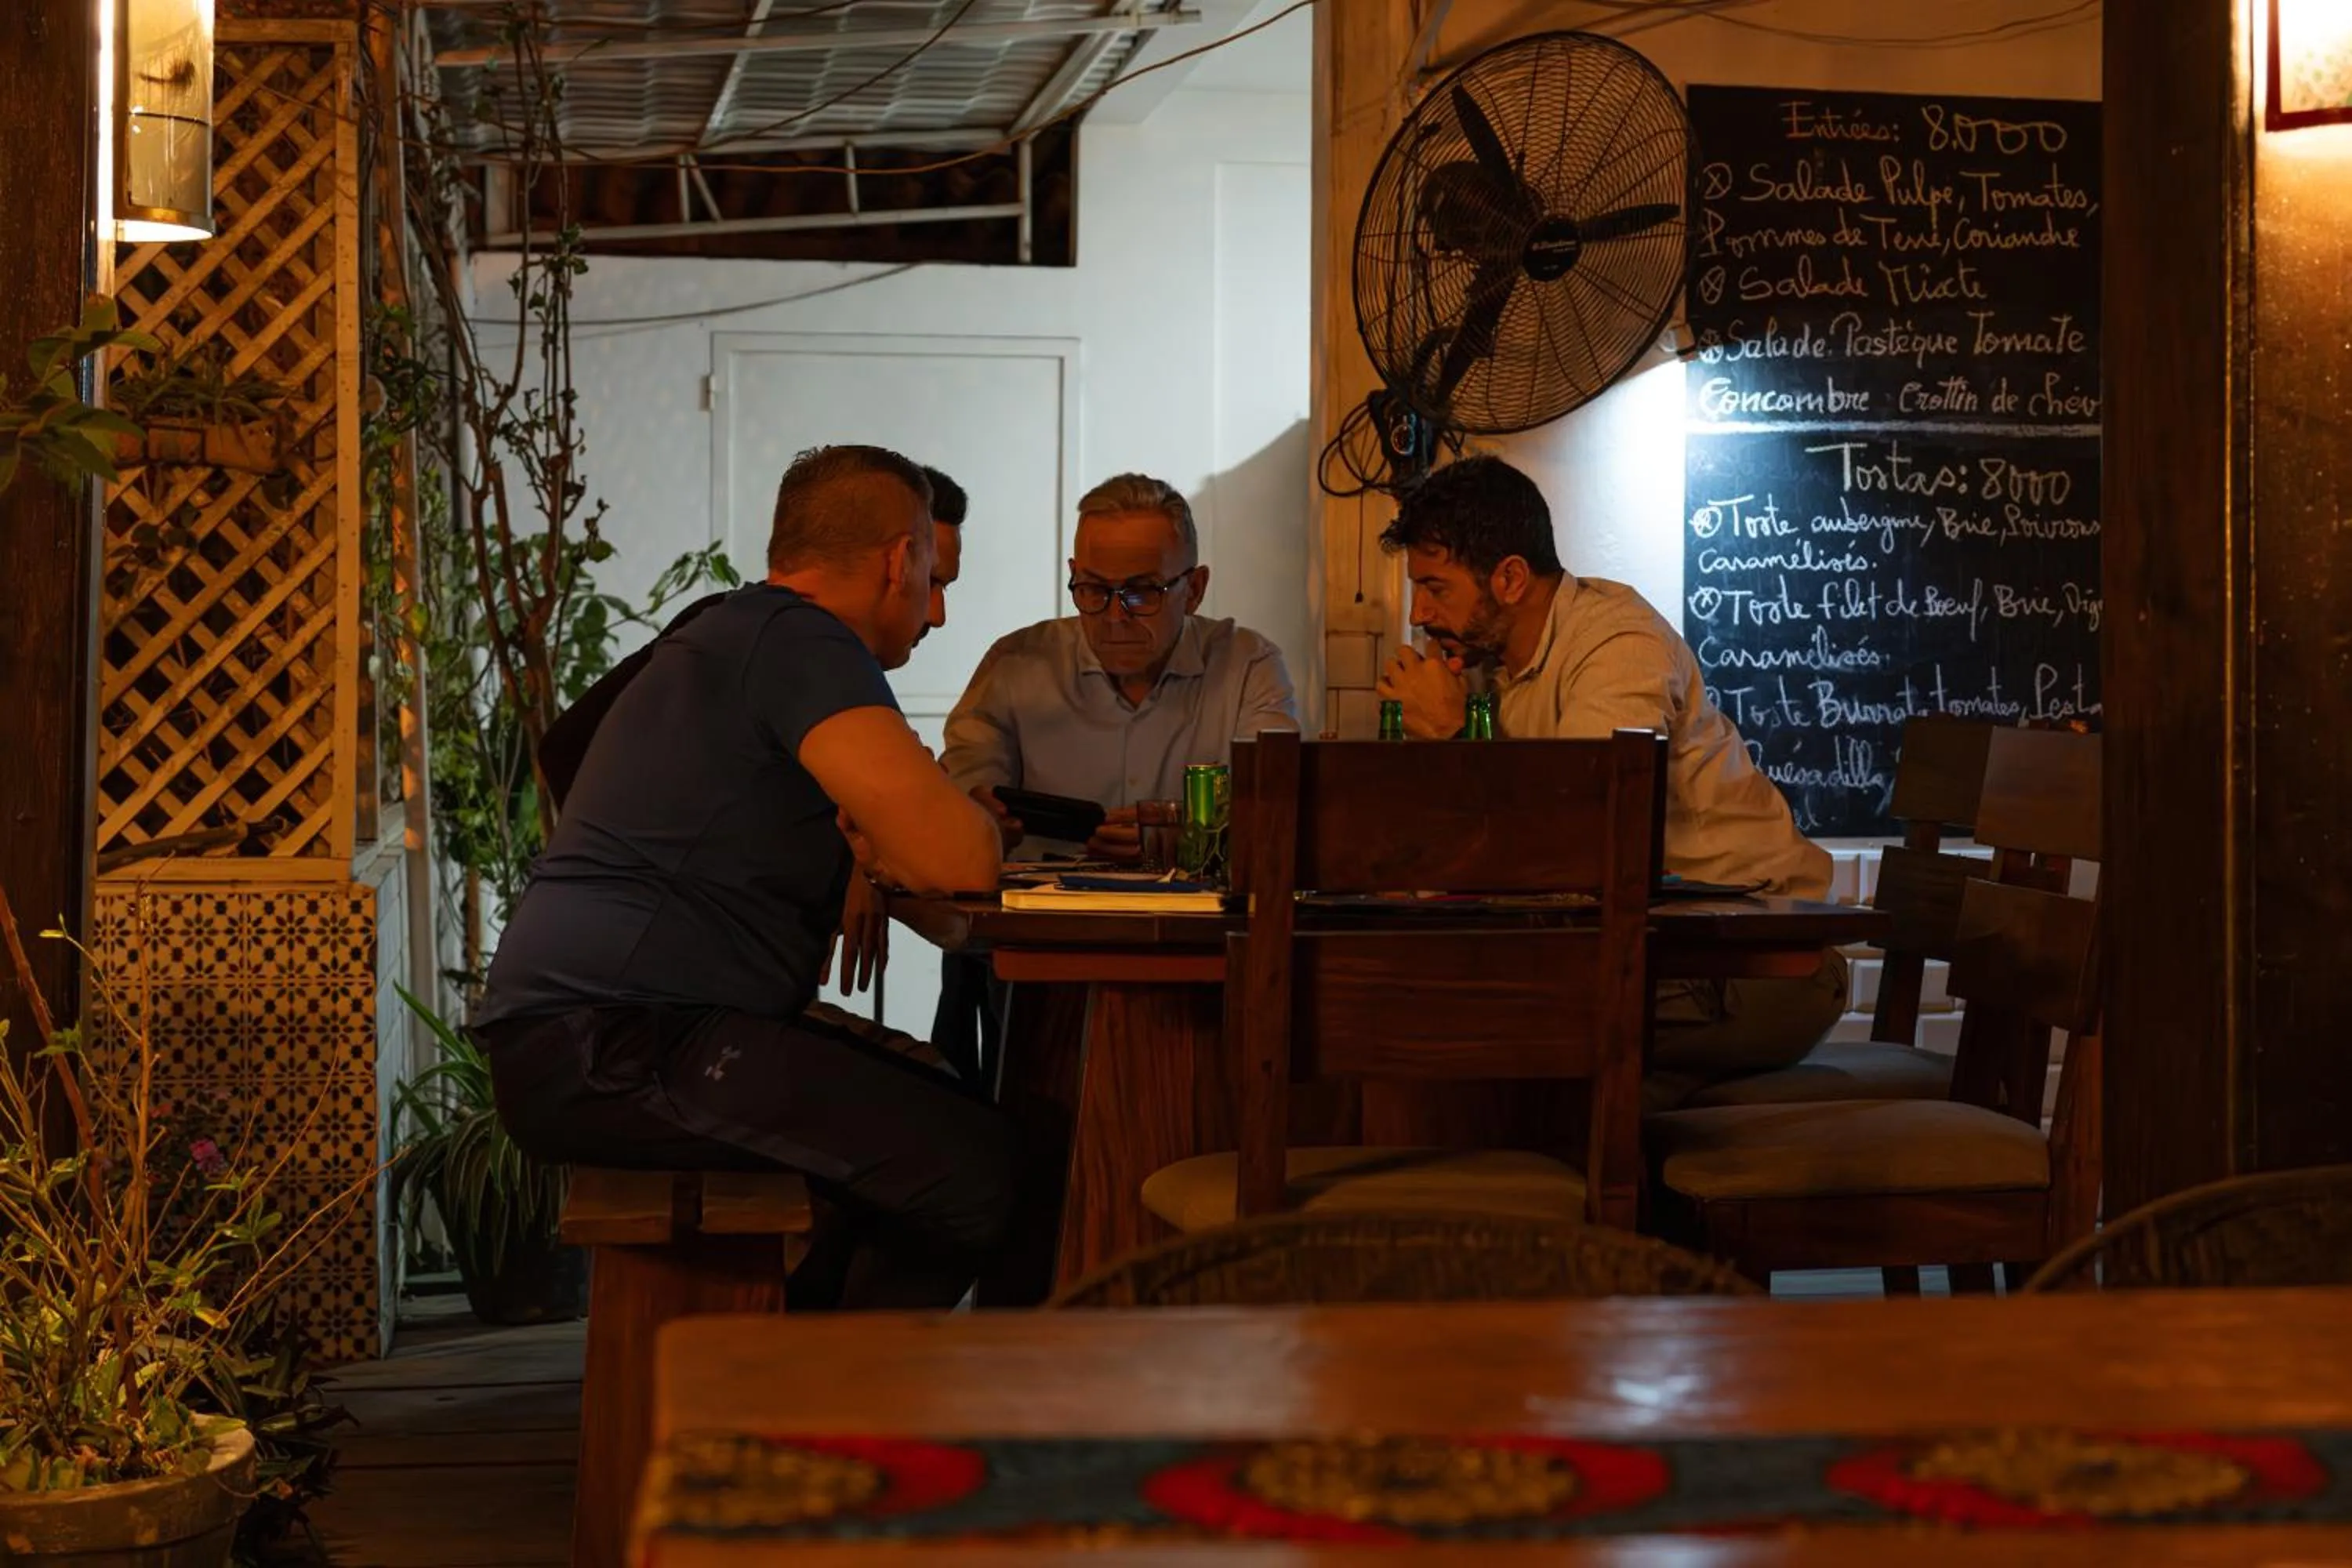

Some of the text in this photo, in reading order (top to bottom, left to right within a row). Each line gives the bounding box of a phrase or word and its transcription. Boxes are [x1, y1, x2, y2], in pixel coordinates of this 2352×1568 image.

[1740, 161, 1875, 204] Salade
[1959, 161, 2100, 218] Tomates,
[1699, 208, 1827, 258] Pommes
[1832, 206, 1867, 247] de
[1953, 209, 2082, 250] Coriandre
[1739, 254, 1869, 300] Salade
[1899, 375, 1980, 414] Crottin
[1991, 376, 2019, 414] de
[1936, 506, 2007, 547] Brie,
[1885, 577, 1916, 618] de
